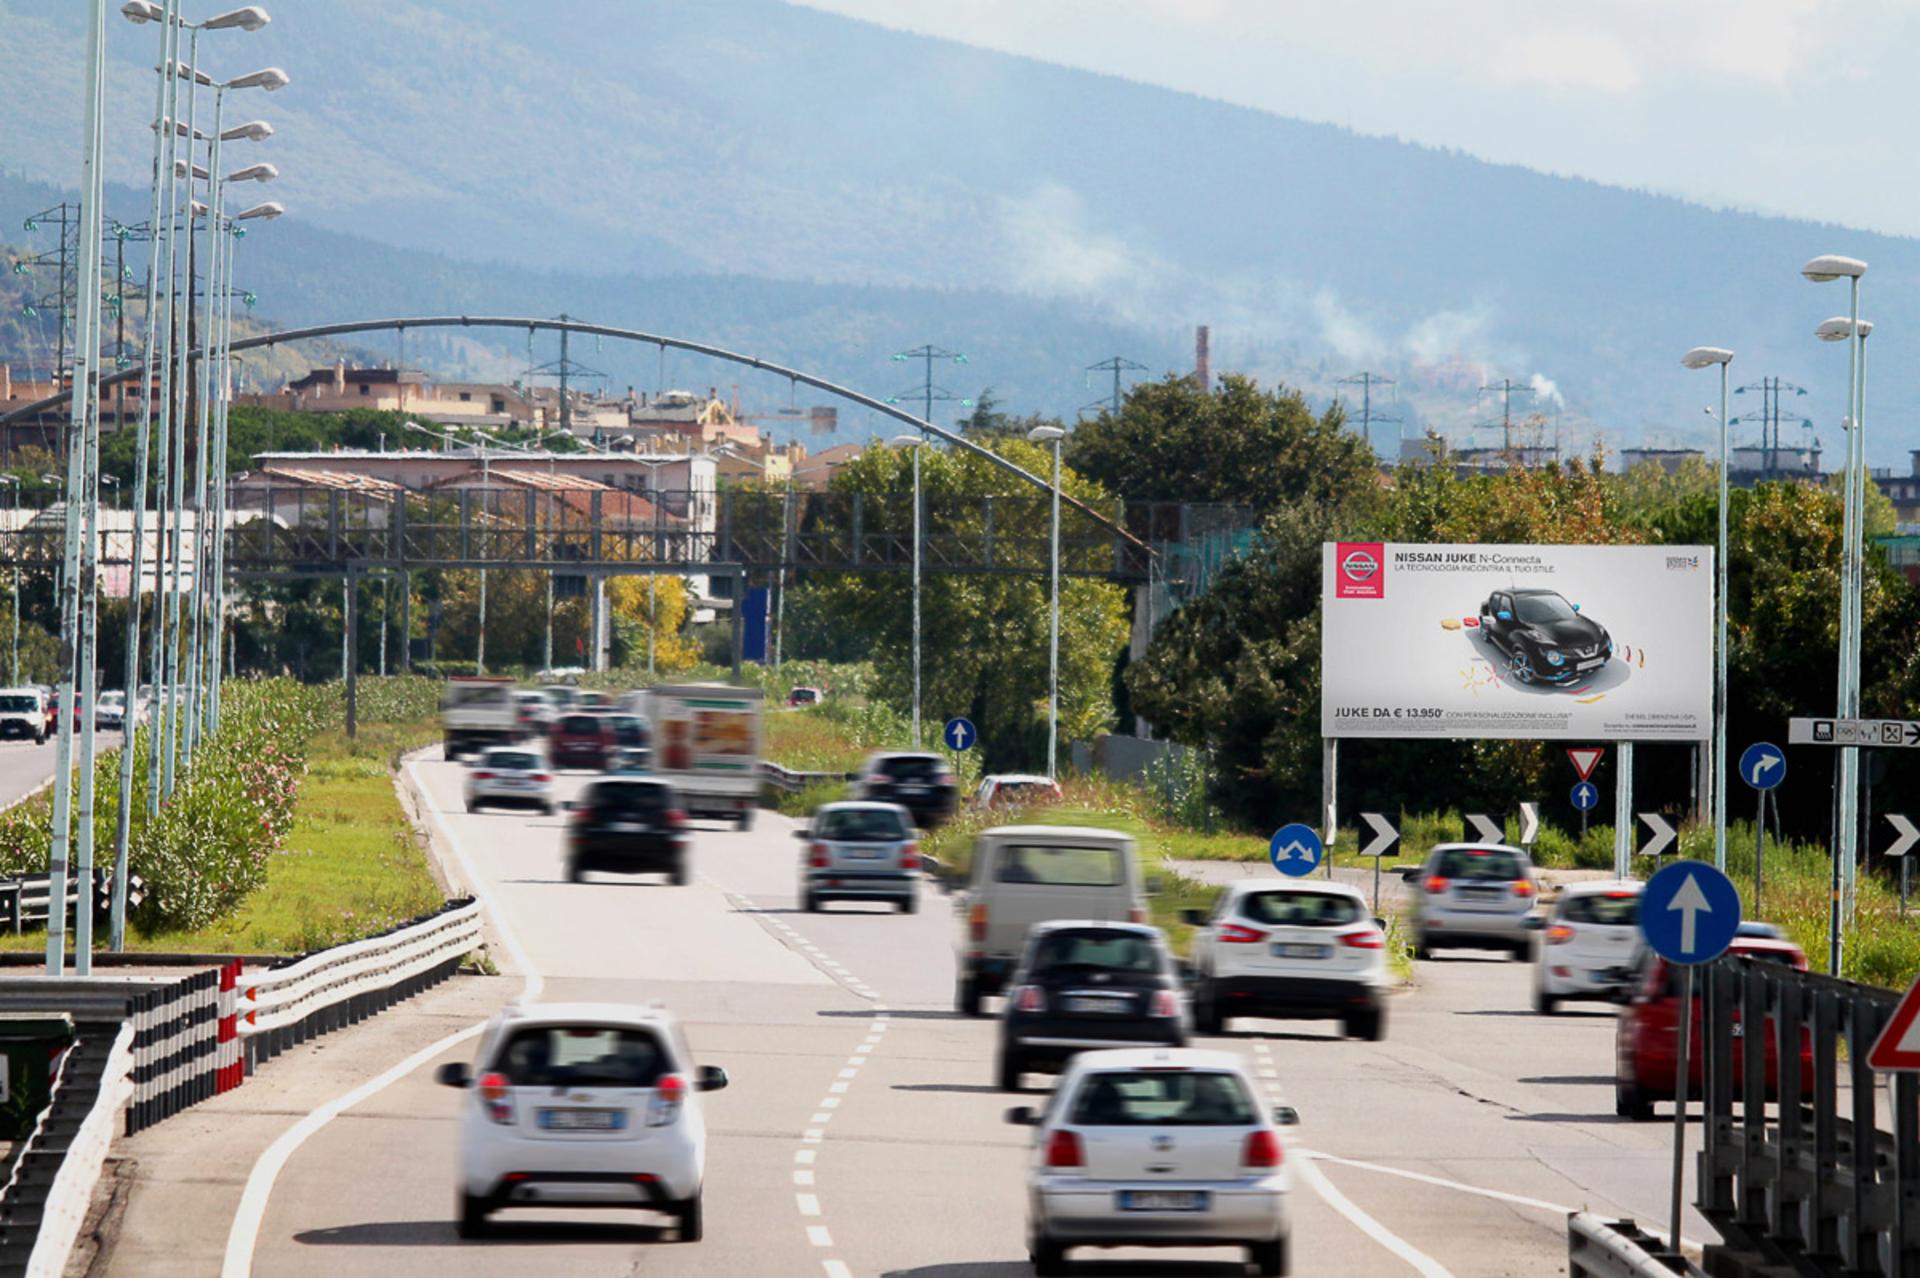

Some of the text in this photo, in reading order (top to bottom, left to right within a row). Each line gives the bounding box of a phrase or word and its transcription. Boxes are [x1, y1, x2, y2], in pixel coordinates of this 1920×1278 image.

[1395, 552, 1542, 564] NISSAN JUKE N-Connecta
[1335, 707, 1369, 718] JUKE
[1373, 707, 1391, 718] DA
[1393, 708, 1403, 718] €
